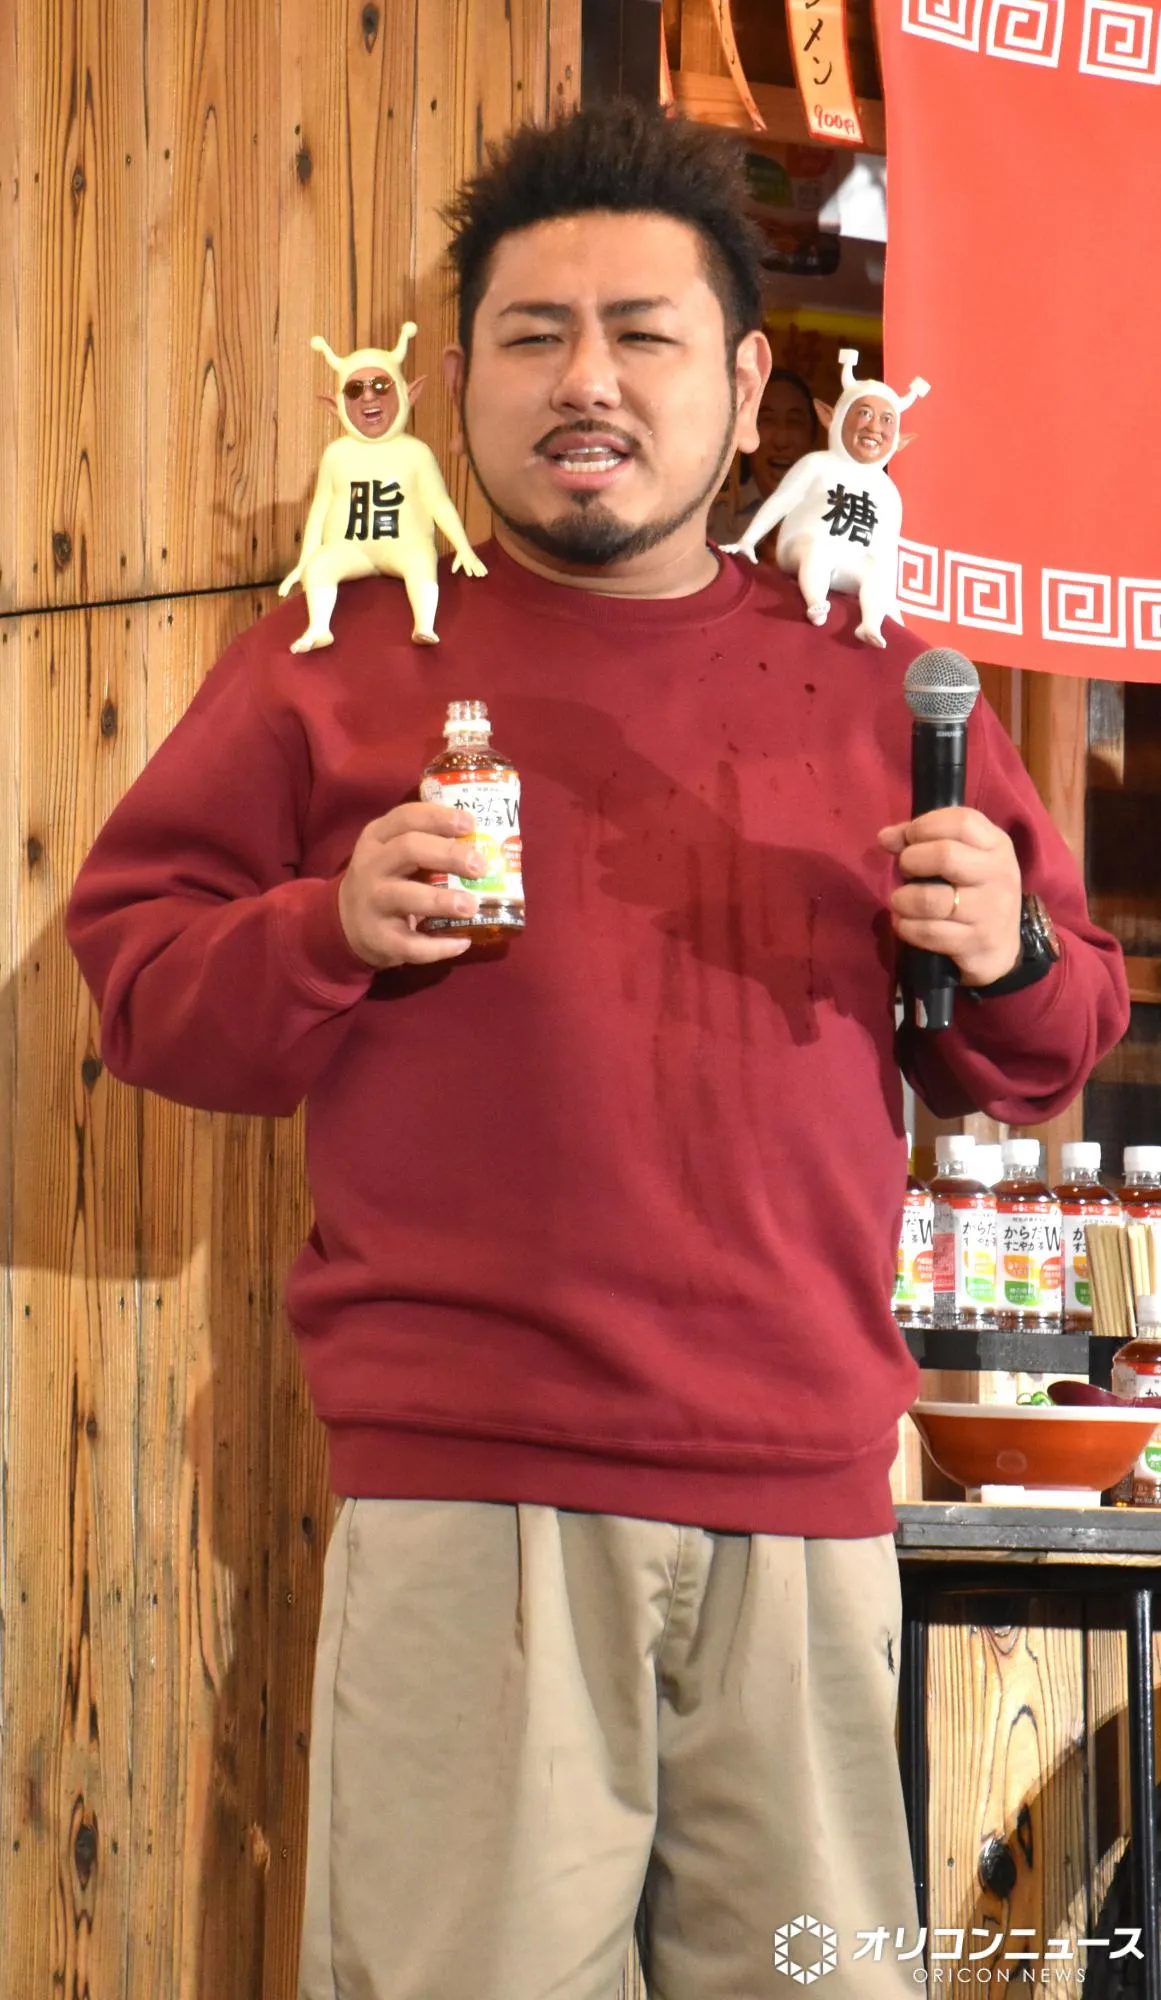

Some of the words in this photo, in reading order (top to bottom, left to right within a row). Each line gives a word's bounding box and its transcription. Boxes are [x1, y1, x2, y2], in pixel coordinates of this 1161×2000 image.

[814, 104, 855, 134] 900円
[344, 479, 405, 541] 脂
[821, 483, 879, 547] 糖
[1004, 1226, 1042, 1241] からだ
